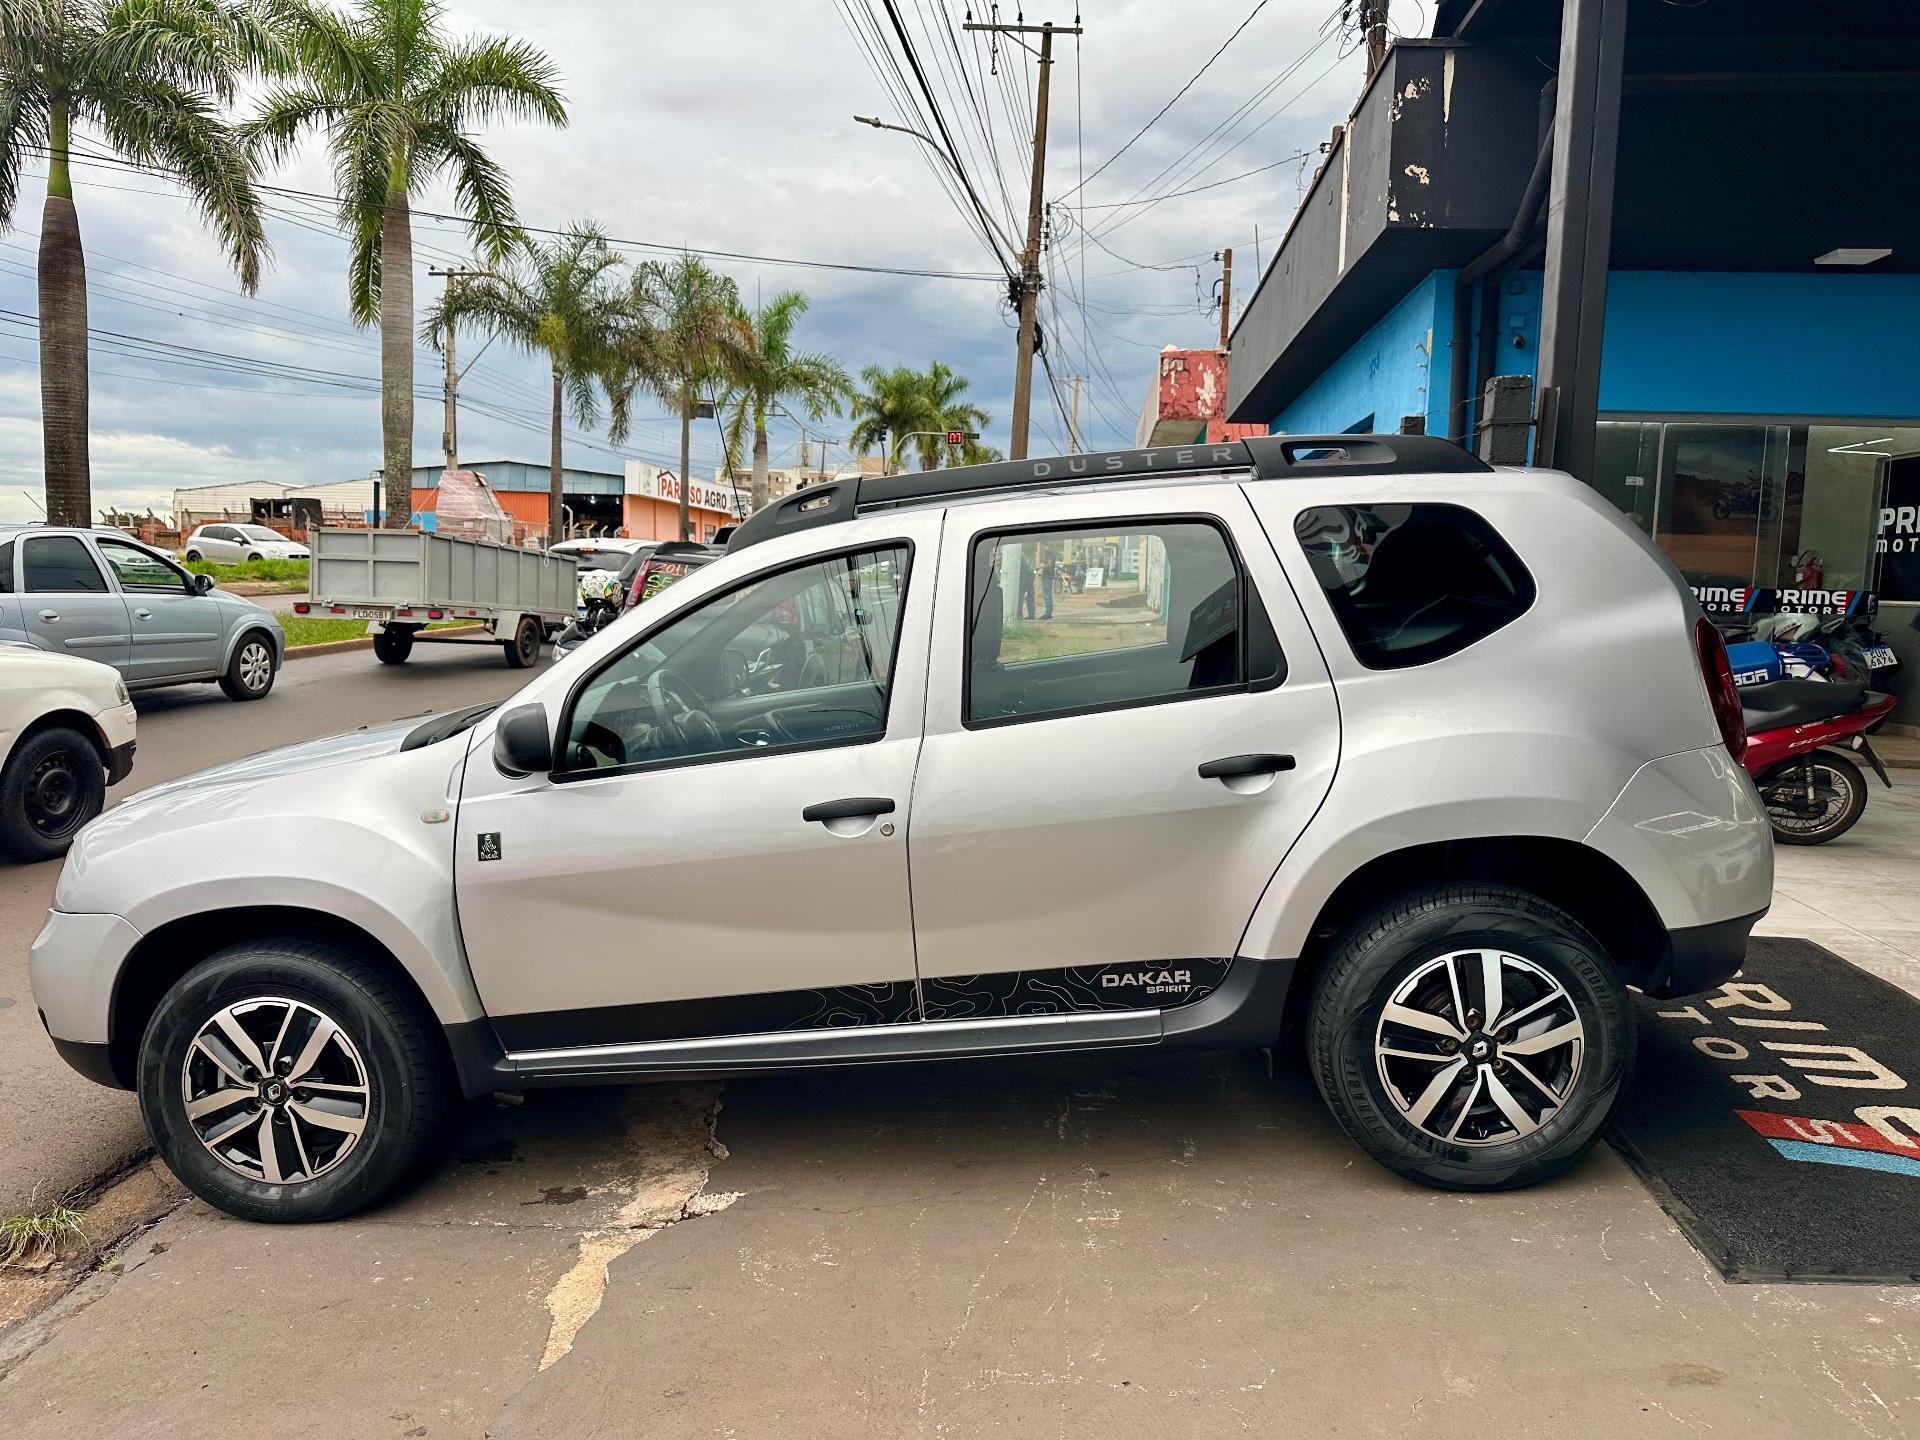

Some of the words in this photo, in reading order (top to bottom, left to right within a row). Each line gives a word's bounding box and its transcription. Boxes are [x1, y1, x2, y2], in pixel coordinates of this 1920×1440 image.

[1033, 447, 1233, 477] DUSTER
[661, 478, 702, 504] PARSO
[704, 489, 727, 509] AGRO
[1101, 969, 1191, 988] DAKAR
[1146, 984, 1191, 994] SPIRIT
